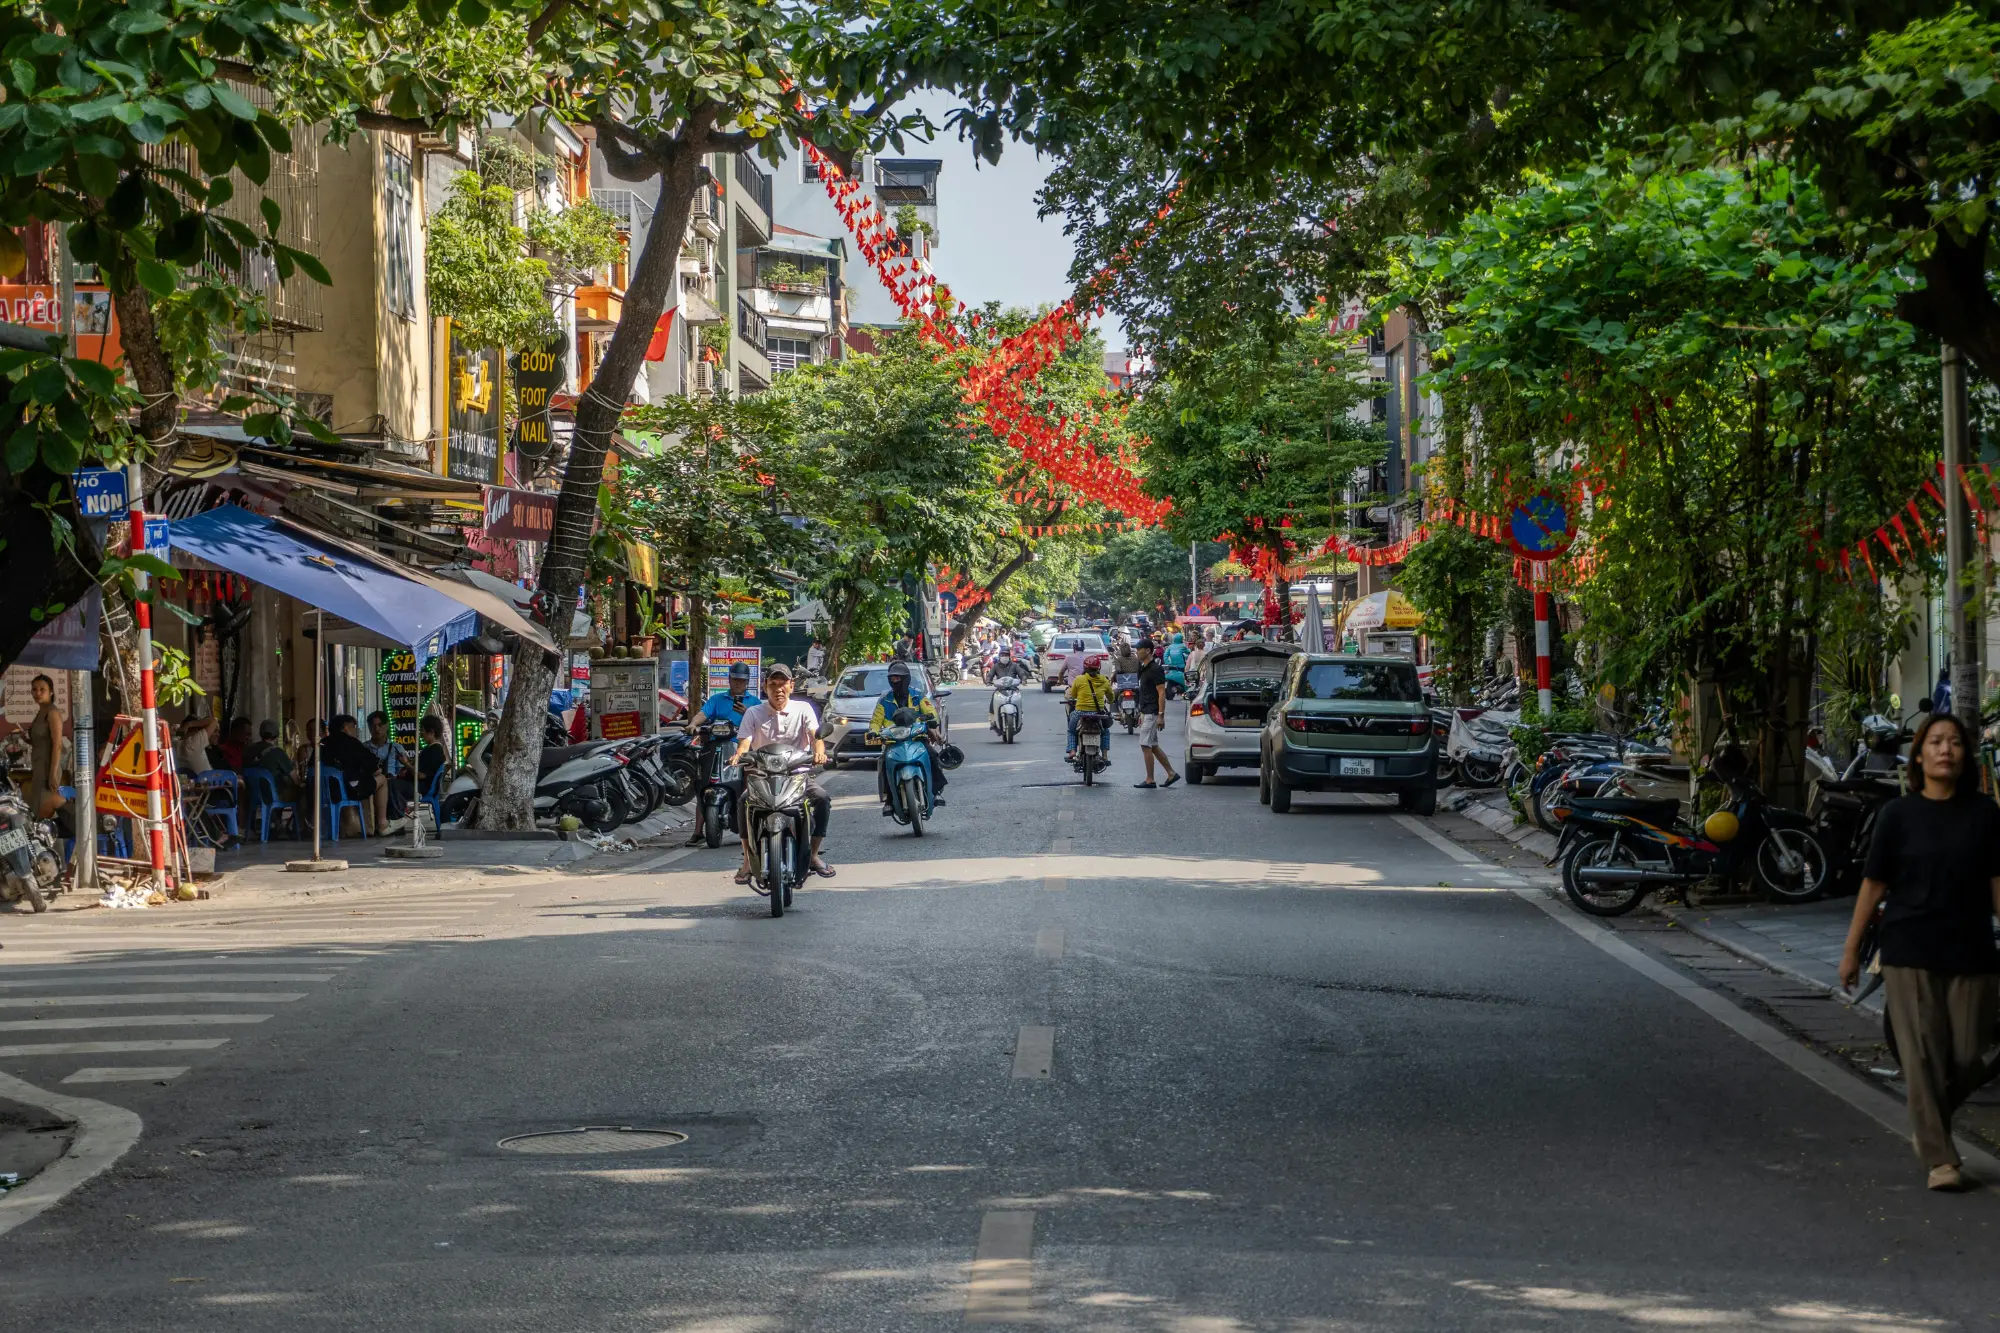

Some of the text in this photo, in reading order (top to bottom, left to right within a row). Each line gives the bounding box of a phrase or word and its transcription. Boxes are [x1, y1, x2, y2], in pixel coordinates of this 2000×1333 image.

[521, 352, 555, 372] BODY
[521, 387, 547, 406] FOOT
[521, 421, 550, 446] NAIL
[86, 490, 123, 514] NÓN
[711, 650, 758, 659] MONEY EXCHANGE
[391, 654, 416, 671] SP
[400, 672, 430, 682] THEPY
[404, 684, 433, 694] HOSONE
[404, 697, 426, 706] SCRB
[401, 709, 417, 719] COLO
[393, 736, 417, 745] FACIA
[1343, 767, 1371, 775] 098.86
